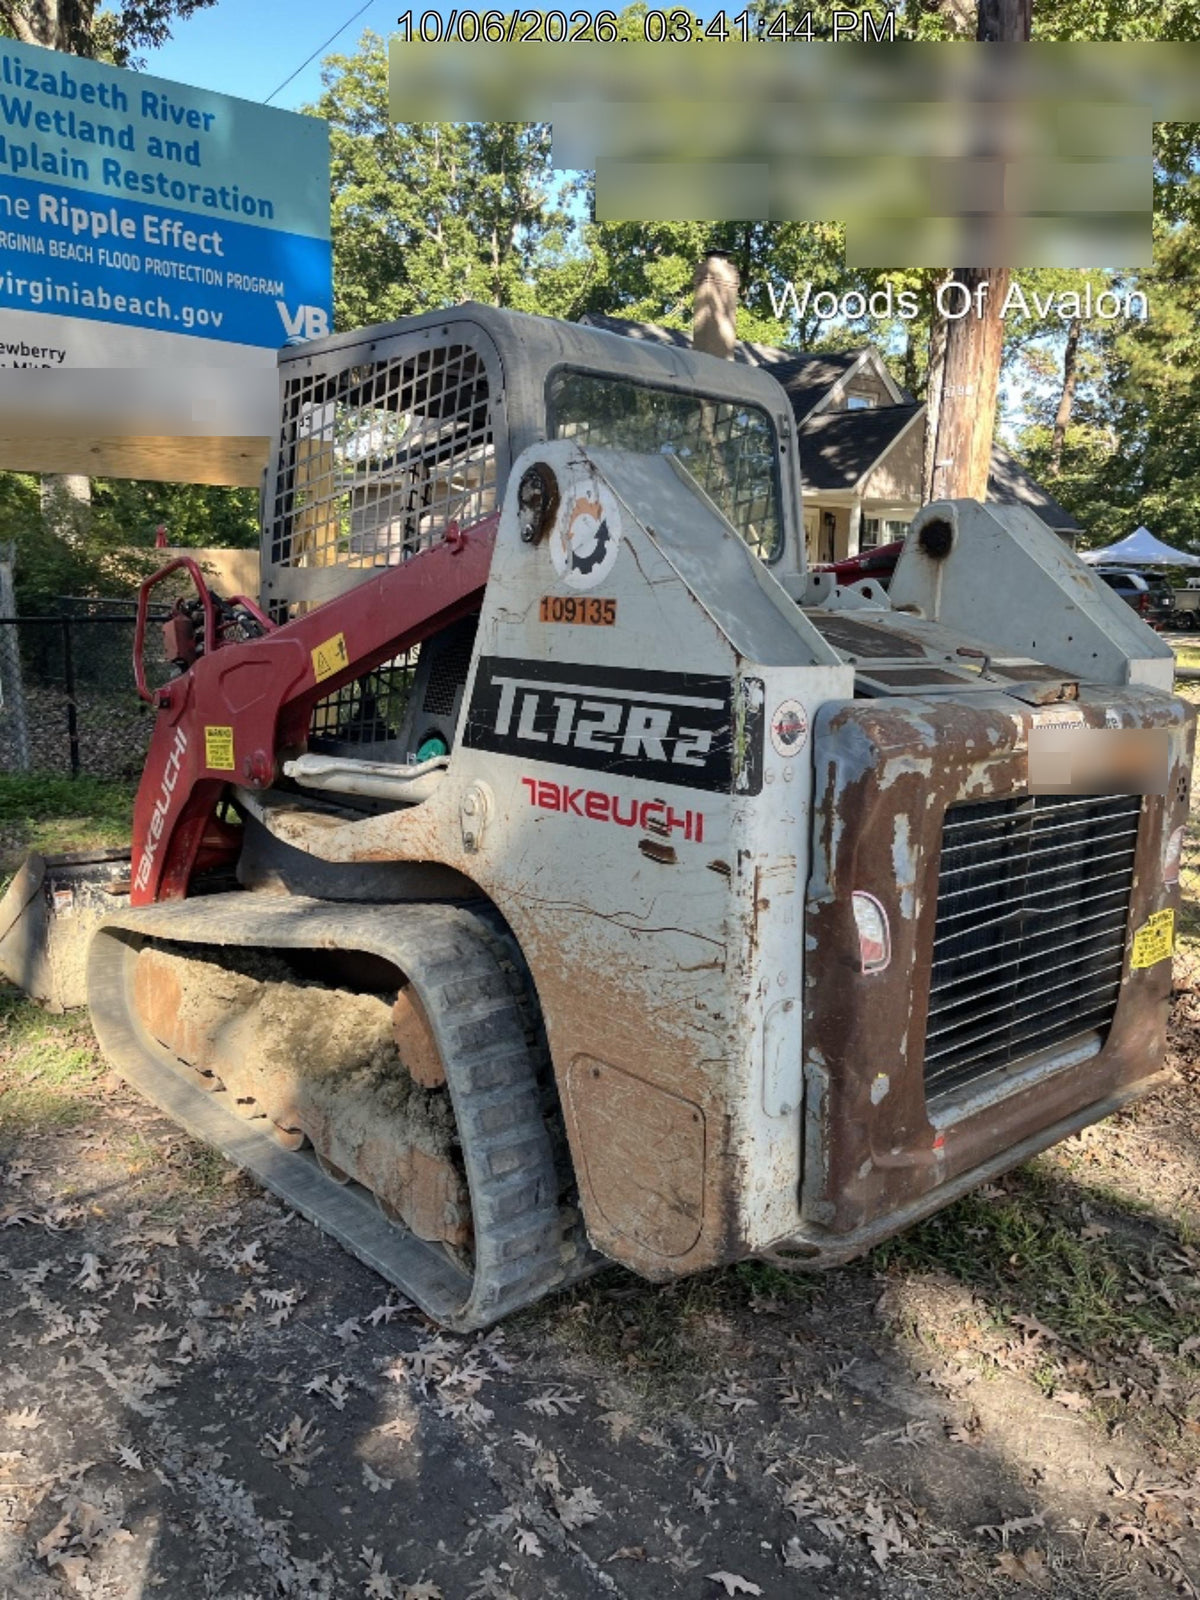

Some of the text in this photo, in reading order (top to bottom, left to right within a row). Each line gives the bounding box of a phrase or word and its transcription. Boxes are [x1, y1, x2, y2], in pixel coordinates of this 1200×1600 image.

[0, 54, 216, 132] lizabeth River
[0, 93, 201, 167] Wetland and
[102, 158, 274, 220] Restoration
[39, 193, 136, 239] Ripple
[143, 215, 225, 257] Effect
[49, 239, 93, 264] BEACH
[98, 248, 141, 273] FLOOD
[145, 257, 223, 287] PROTECTION
[227, 272, 284, 298] PROGRAM
[275, 300, 330, 340] VB
[541, 596, 616, 626] 109135
